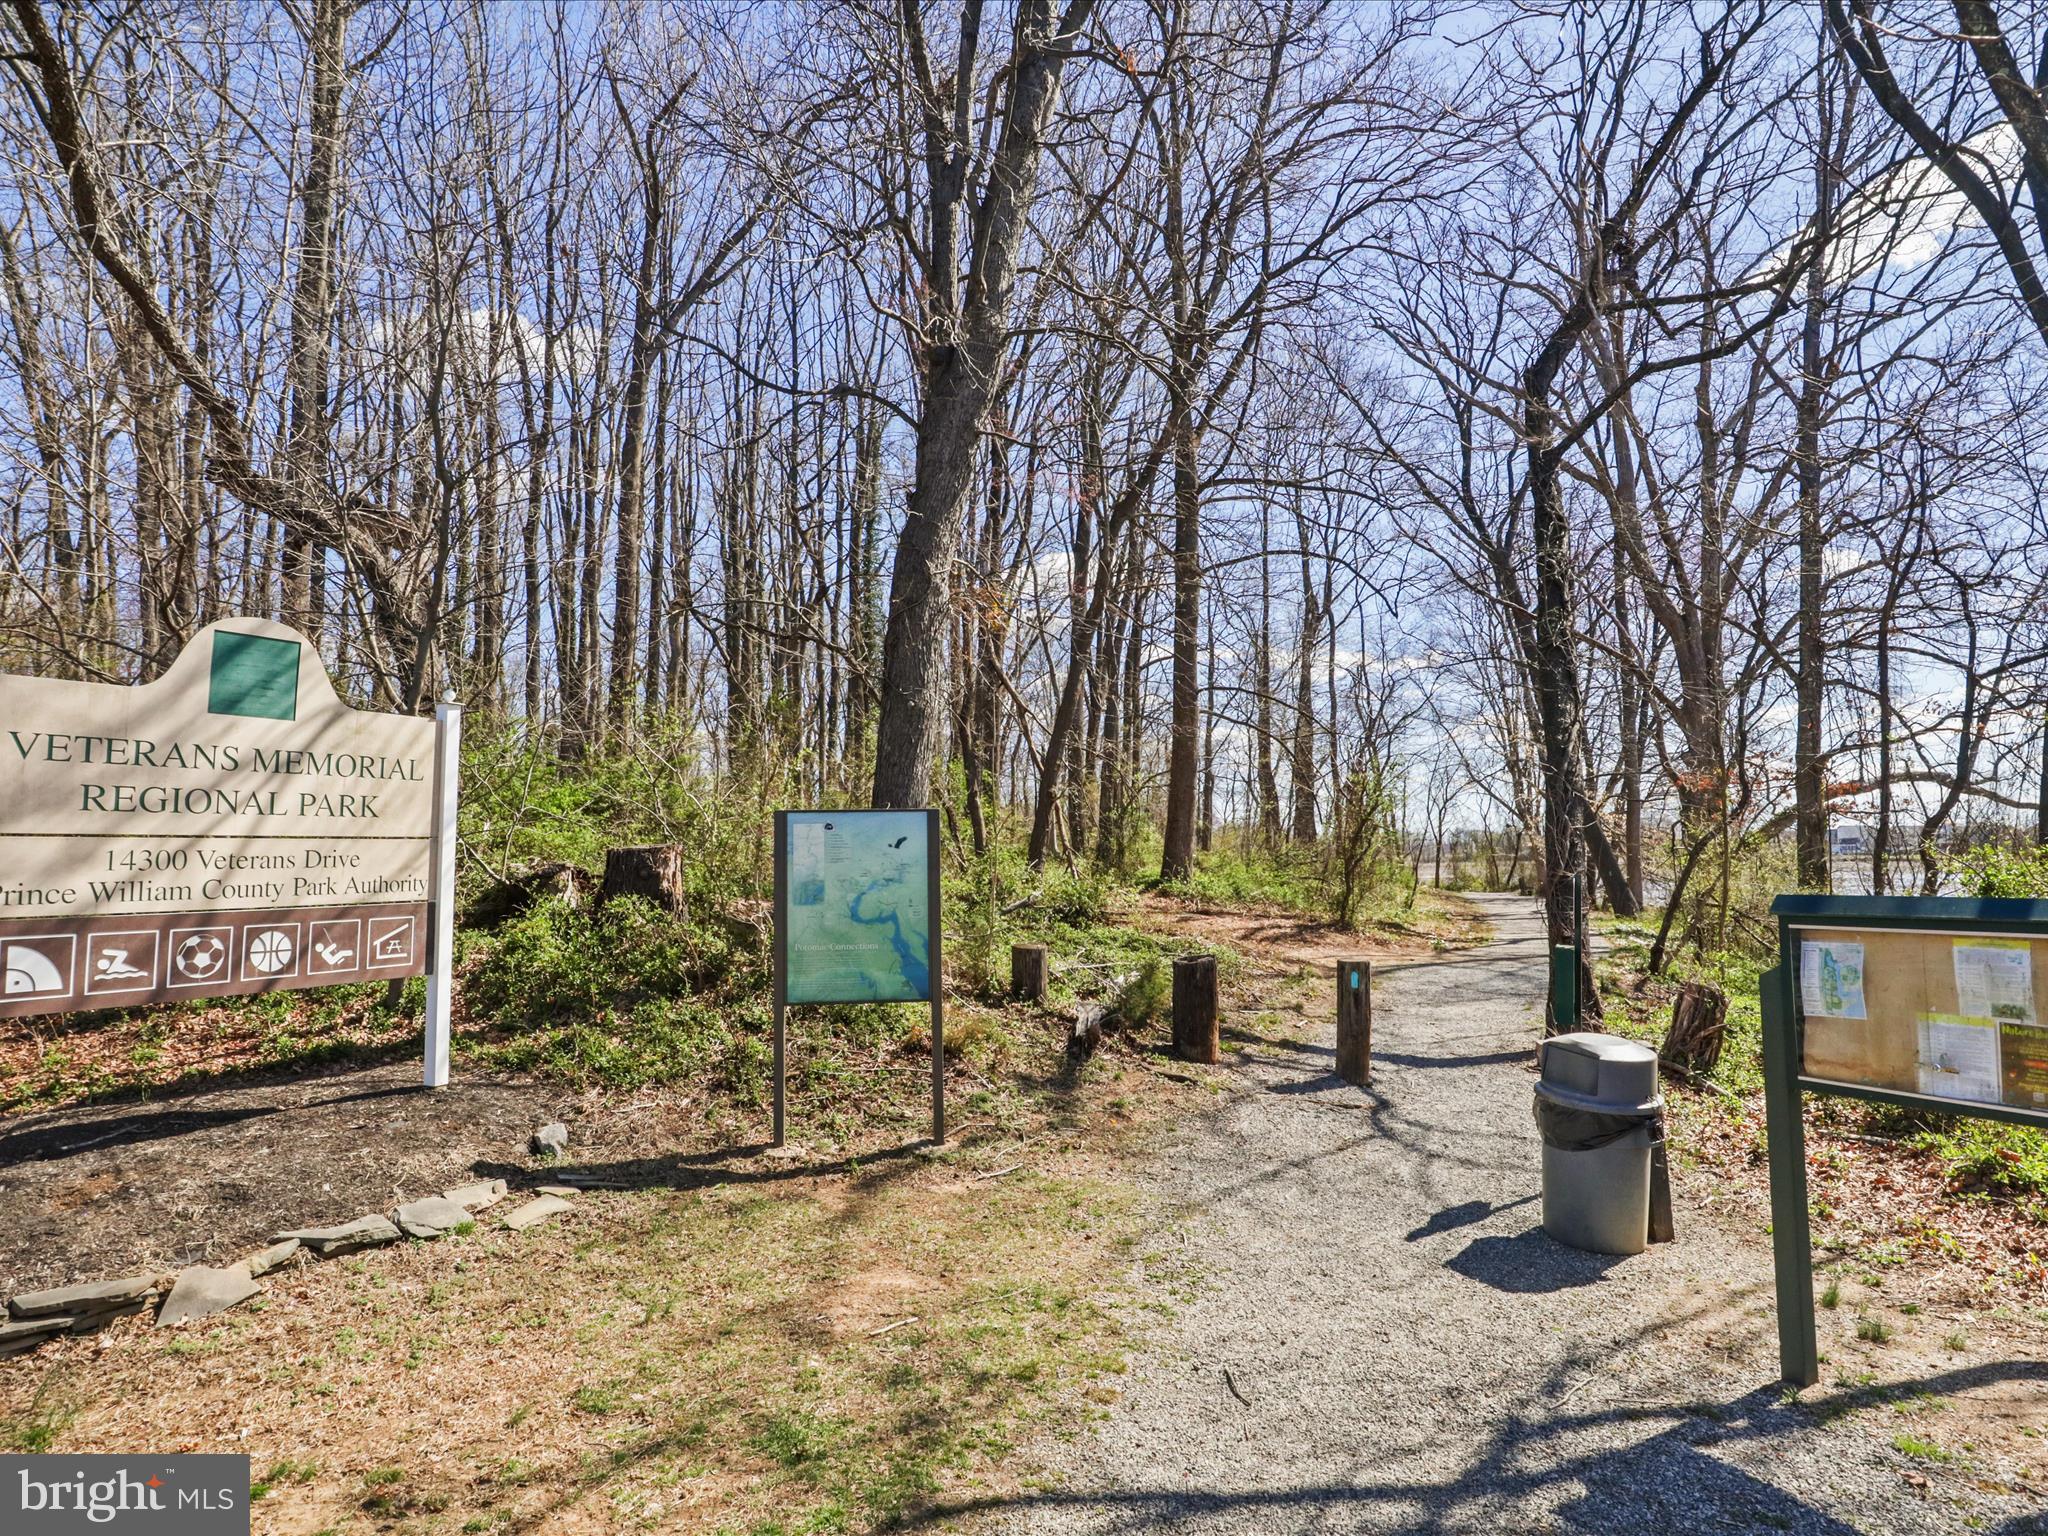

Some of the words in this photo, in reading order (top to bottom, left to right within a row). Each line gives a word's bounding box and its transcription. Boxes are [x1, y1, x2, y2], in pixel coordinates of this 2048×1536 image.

[8, 730, 239, 772] VETERANS
[250, 747, 425, 782] MEMORIAL
[78, 783, 288, 817] REGIONAL
[297, 793, 379, 818] PARK
[106, 849, 188, 872] 14300
[196, 849, 296, 870] Veterans
[304, 849, 361, 869] Drive
[0, 882, 77, 906] rince
[88, 879, 192, 903] William
[202, 878, 285, 903] County
[293, 876, 337, 897] Park
[344, 874, 428, 897] Authority
